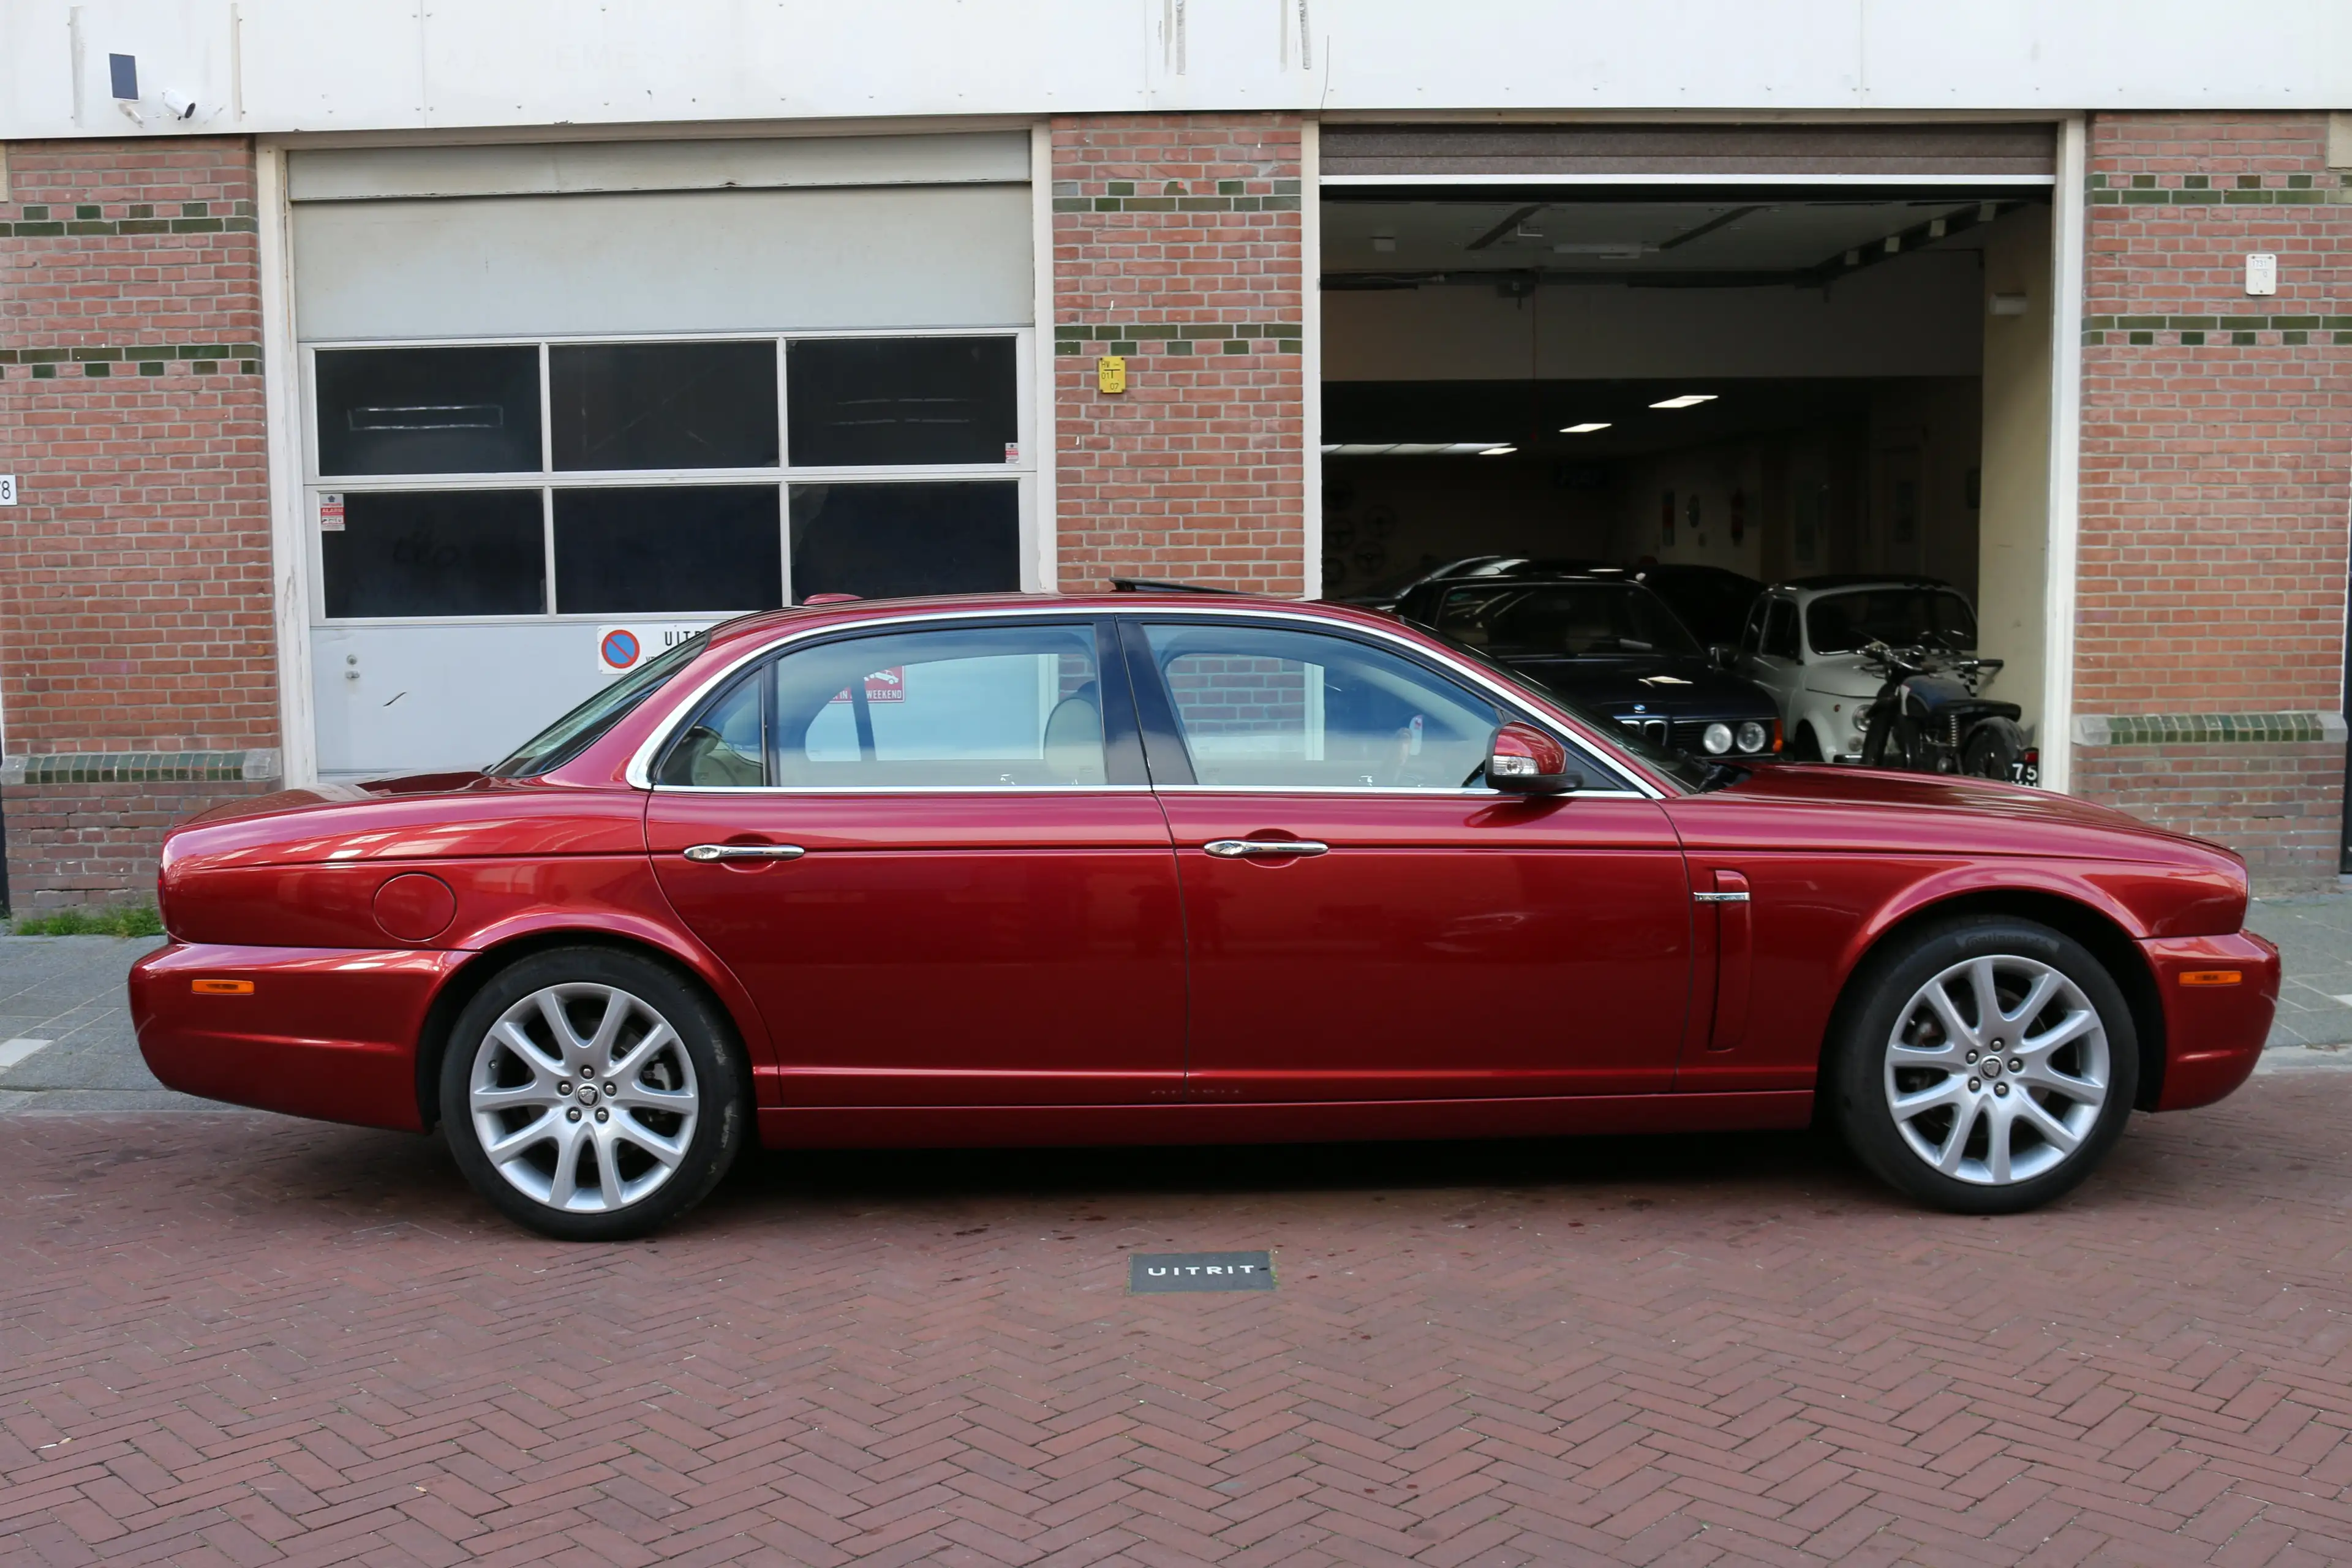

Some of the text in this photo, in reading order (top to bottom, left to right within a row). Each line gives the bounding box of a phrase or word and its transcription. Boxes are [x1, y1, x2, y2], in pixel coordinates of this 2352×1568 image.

[0, 480, 10, 500] 8
[840, 690, 848, 699] IN
[866, 690, 902, 699] WEEKEND
[2012, 763, 2037, 781] 75
[1147, 1265, 1254, 1276] UITRIT
